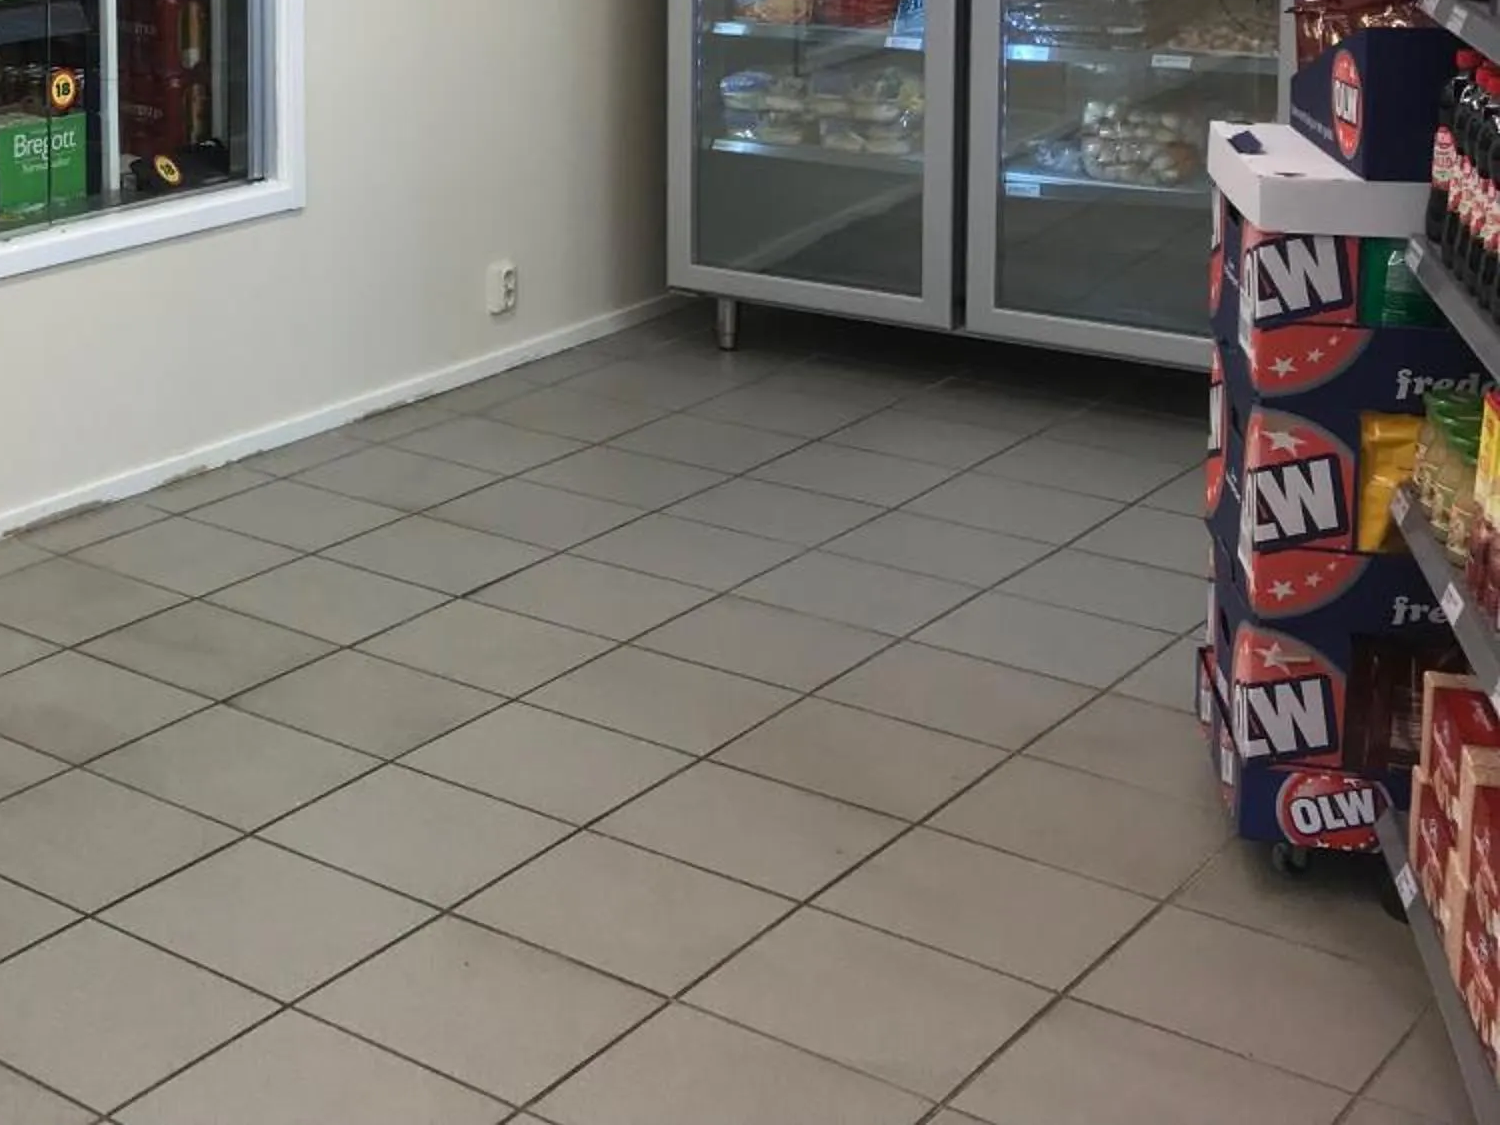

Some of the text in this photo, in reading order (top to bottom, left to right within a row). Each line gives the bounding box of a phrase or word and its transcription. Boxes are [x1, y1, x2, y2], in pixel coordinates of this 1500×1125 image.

[55, 82, 71, 97] 18
[13, 131, 77, 161] Bregott
[1290, 787, 1376, 835] OLW
